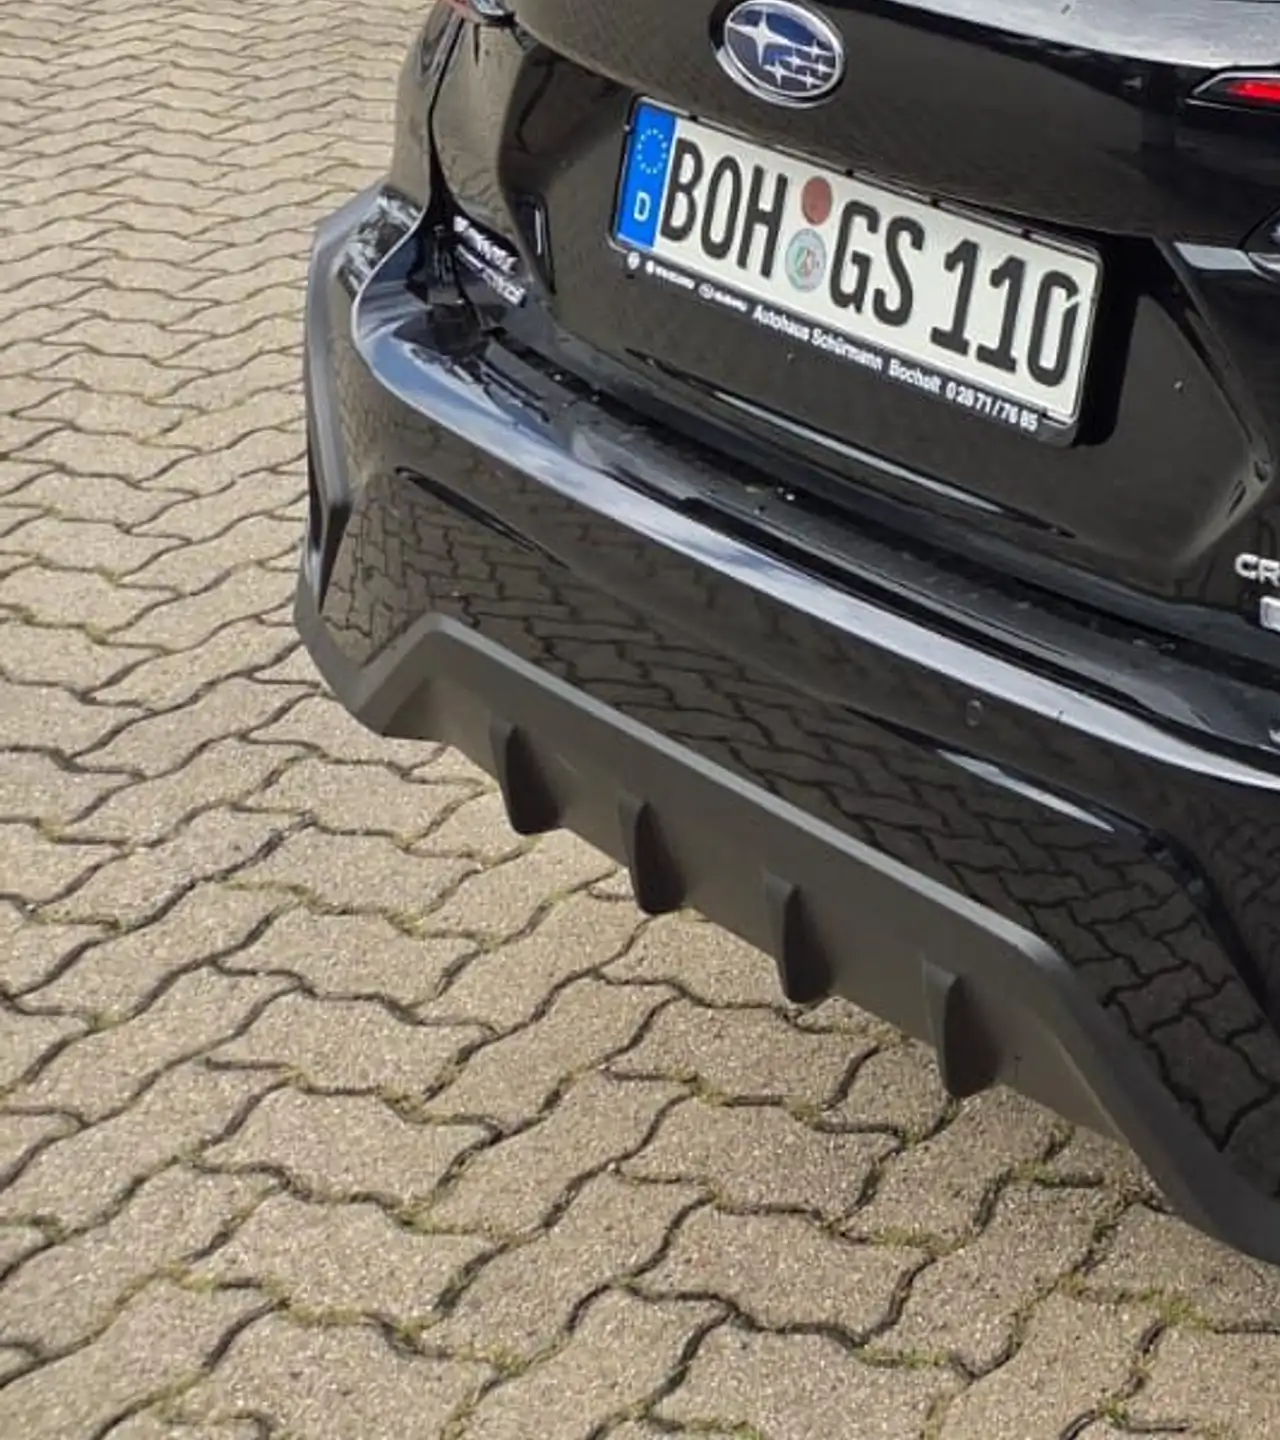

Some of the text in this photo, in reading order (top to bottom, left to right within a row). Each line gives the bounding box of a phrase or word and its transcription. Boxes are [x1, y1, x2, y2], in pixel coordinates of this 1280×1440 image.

[634, 191, 651, 222] D
[660, 136, 788, 279] BOH
[829, 200, 925, 327] GS
[930, 237, 1080, 387] 110
[752, 304, 810, 342] Autohaus
